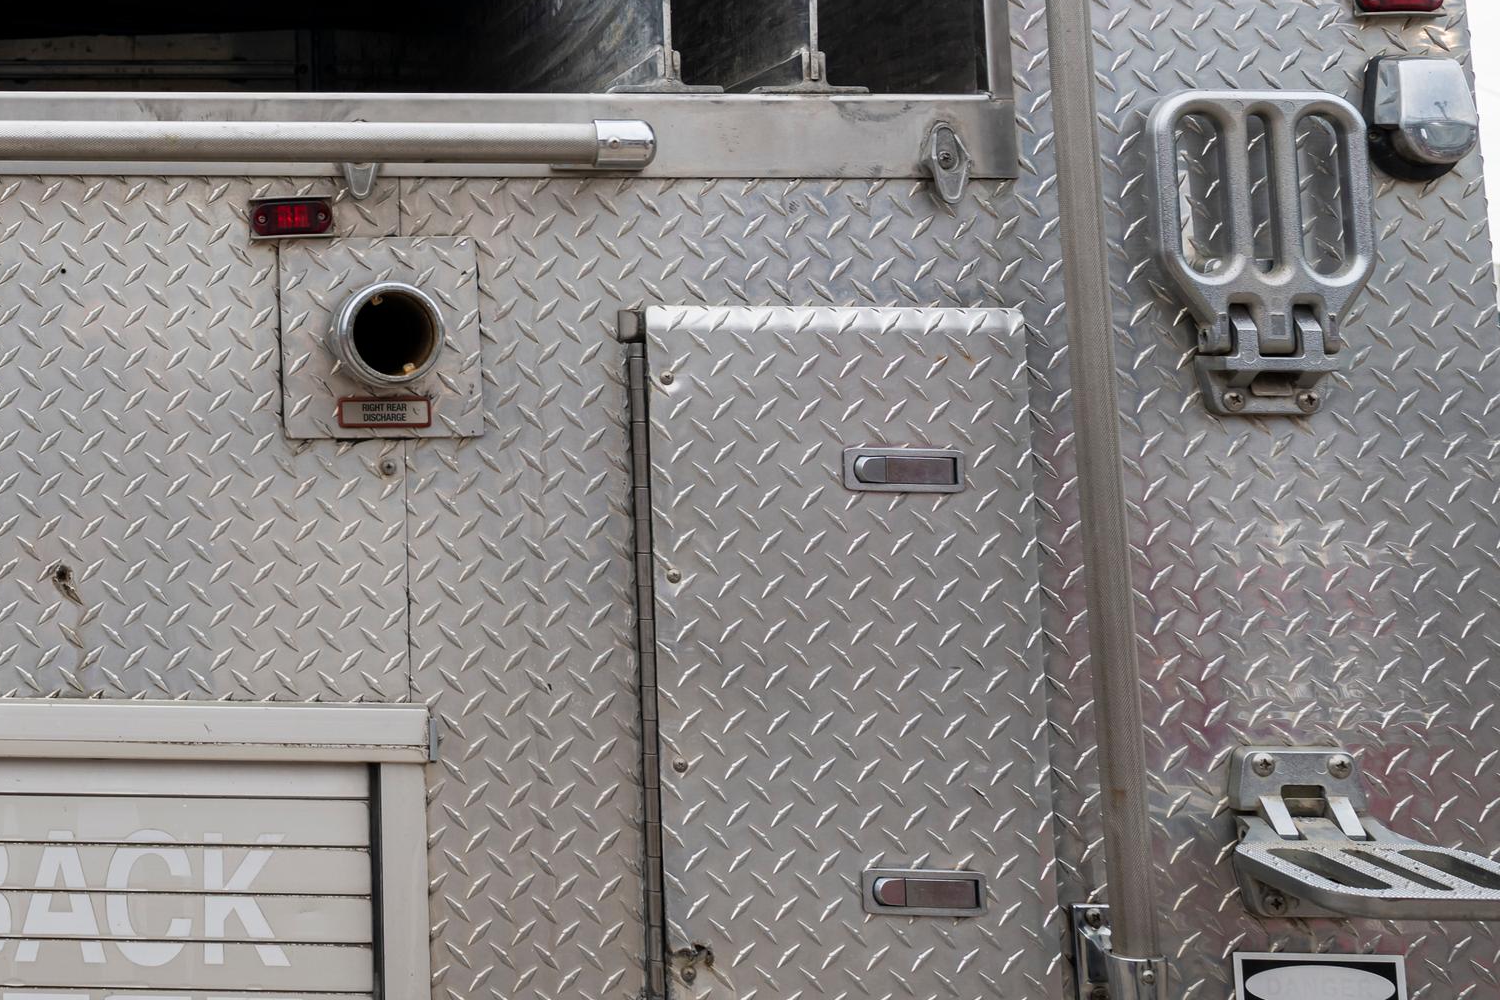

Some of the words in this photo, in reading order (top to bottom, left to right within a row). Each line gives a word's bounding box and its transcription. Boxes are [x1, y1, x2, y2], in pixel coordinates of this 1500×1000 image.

[362, 403, 384, 412] RIGHT
[386, 403, 407, 412] REAR
[363, 413, 407, 422] DISCHARGE
